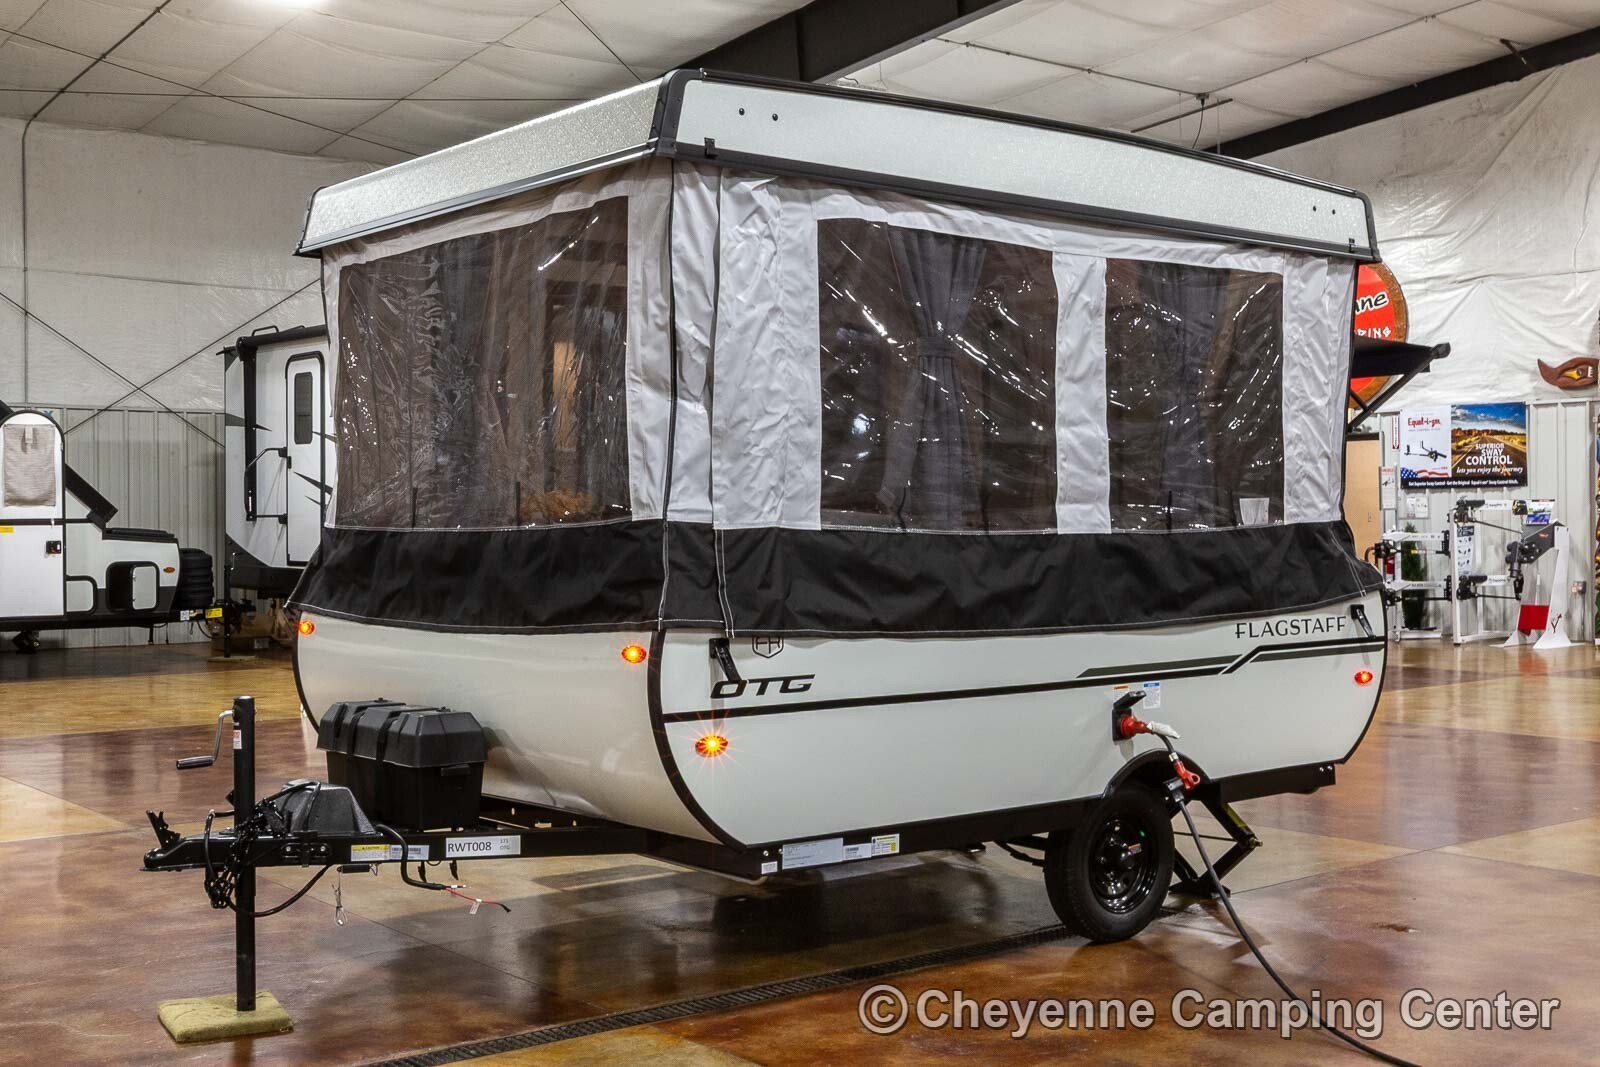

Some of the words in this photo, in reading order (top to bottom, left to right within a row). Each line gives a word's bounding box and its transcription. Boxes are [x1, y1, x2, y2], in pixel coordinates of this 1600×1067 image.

[1475, 442, 1505, 450] SUPERIOR
[1481, 449, 1503, 457] SWAY
[1465, 455, 1512, 465] CONTROL
[1477, 467, 1491, 475] enjoy
[1235, 616, 1346, 638] FLAGSTAFF
[710, 674, 815, 698] OTG
[448, 842, 492, 852] RWT008
